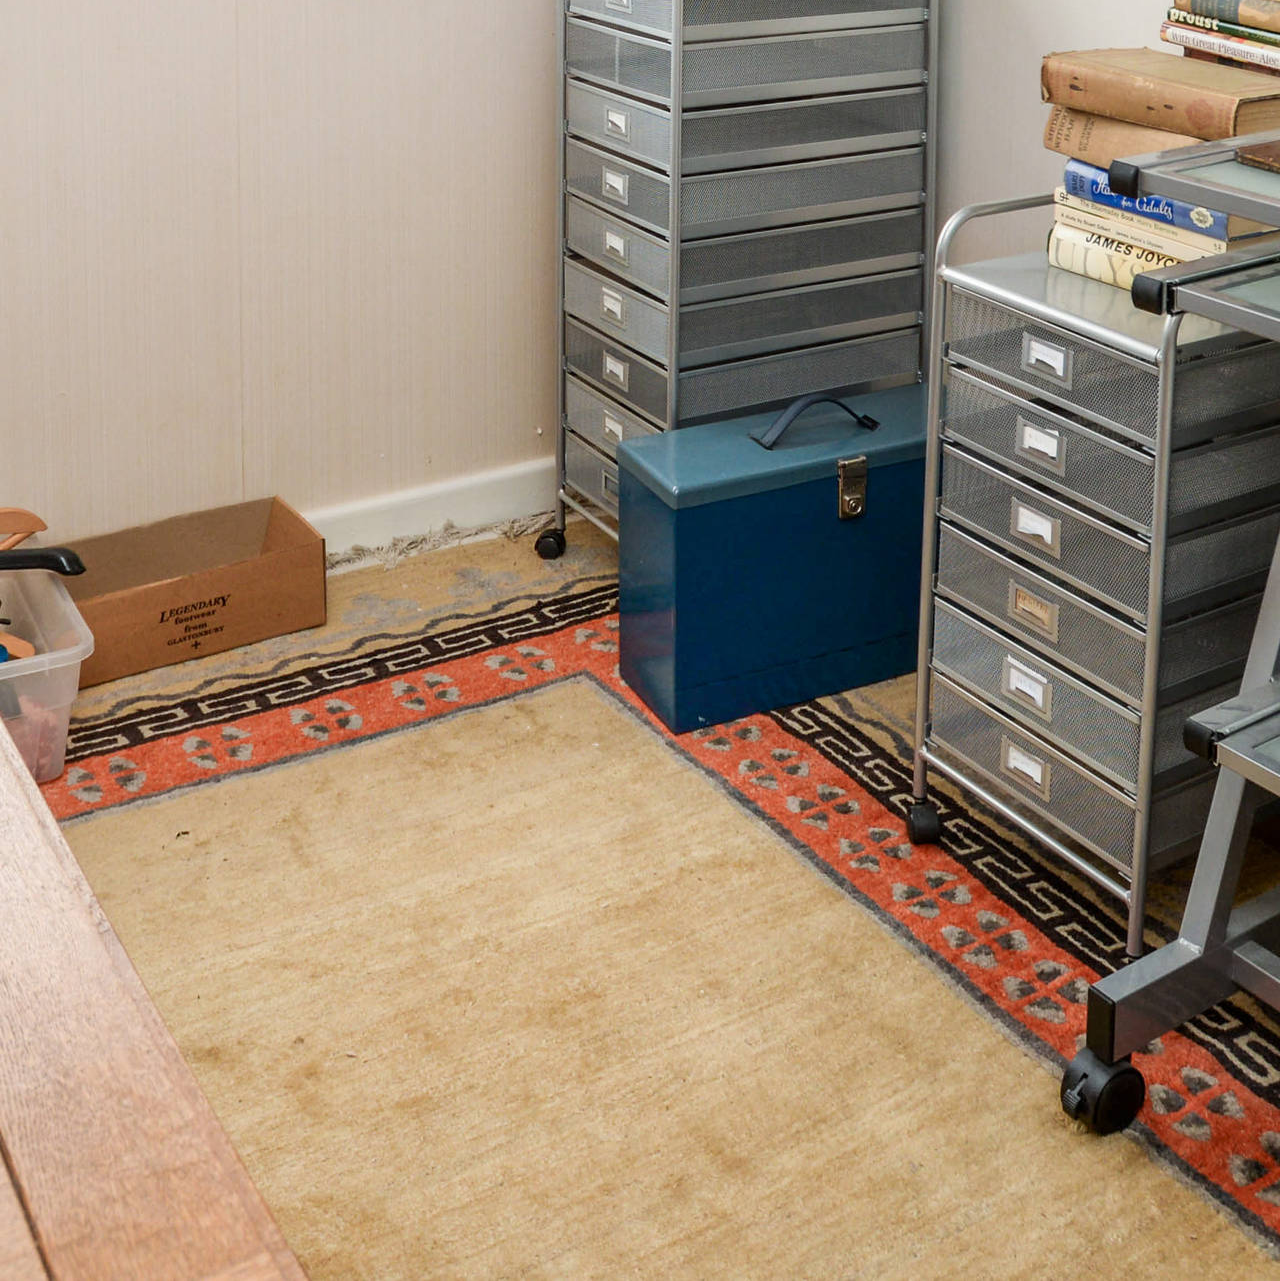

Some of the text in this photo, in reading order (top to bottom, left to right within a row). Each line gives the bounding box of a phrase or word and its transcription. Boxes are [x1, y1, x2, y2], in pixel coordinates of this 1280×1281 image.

[1170, 8, 1219, 31] proust
[1171, 30, 1190, 43] With
[1192, 35, 1216, 50] Great
[1259, 54, 1280, 66] Alec
[1065, 119, 1074, 142] BAR
[1080, 198, 1178, 236] The Bloomsday Book Harry Blamires
[1121, 195, 1173, 220] for Adults
[1065, 214, 1076, 222] study
[1083, 219, 1096, 228] Stuart
[1097, 223, 1112, 233] Gilbert
[1115, 230, 1128, 238] James
[1085, 233, 1134, 255] JAMES
[159, 594, 231, 623] LEGENDARY
[175, 610, 216, 625] footwear
[167, 625, 224, 646] GLASTONBURY
[185, 622, 207, 633] from
